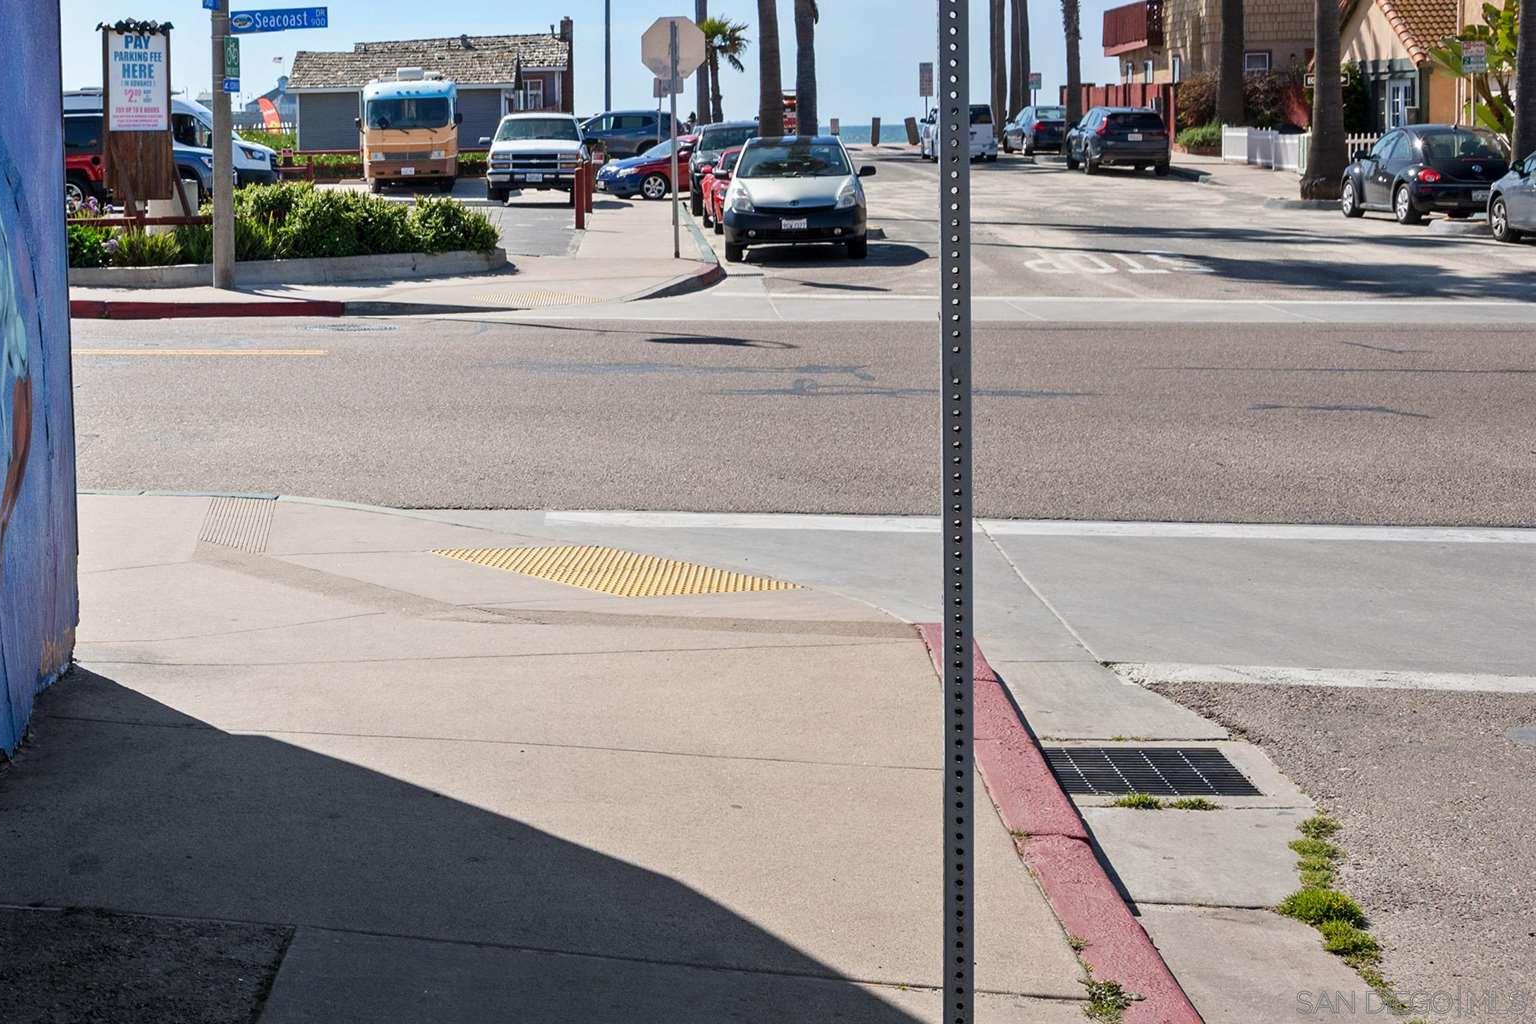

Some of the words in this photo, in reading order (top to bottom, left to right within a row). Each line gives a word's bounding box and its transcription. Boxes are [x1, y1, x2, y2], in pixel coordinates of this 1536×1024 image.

[255, 11, 308, 28] Seacoast
[310, 18, 326, 27] 900
[124, 35, 151, 49] PAY
[114, 51, 148, 62] PARKING
[149, 51, 162, 62] FEE
[122, 63, 154, 79] HERE
